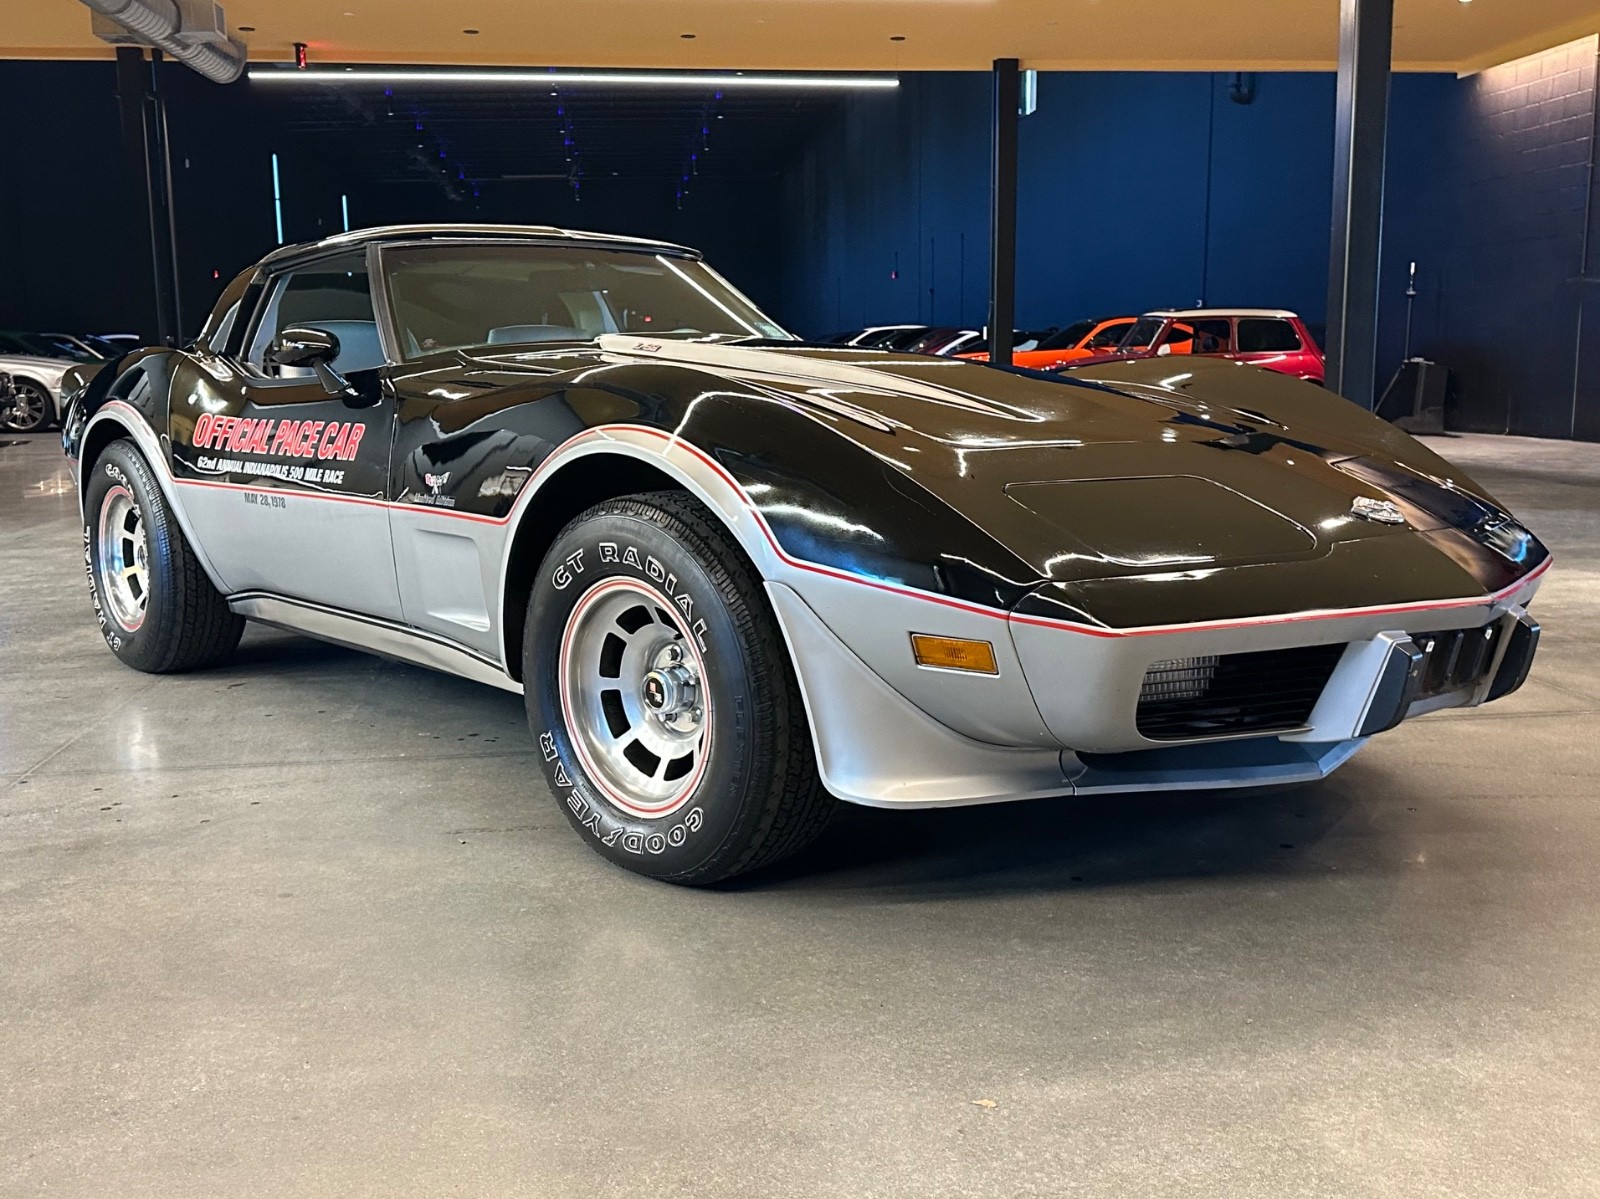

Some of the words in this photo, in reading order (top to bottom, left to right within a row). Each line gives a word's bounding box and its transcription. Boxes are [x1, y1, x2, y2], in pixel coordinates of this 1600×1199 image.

[192, 412, 276, 455] OFFICIAL
[269, 419, 325, 459] PACE
[317, 421, 366, 461] CAR
[197, 456, 216, 470] 62nd
[216, 458, 244, 474] ANNUAL
[243, 461, 290, 478] INDIANAPOLIS
[289, 466, 303, 480] 500
[304, 467, 323, 482] MILE
[323, 469, 345, 484] RACE
[244, 492, 258, 505] MAY
[552, 548, 585, 590] GT
[598, 542, 708, 654] RADIAL
